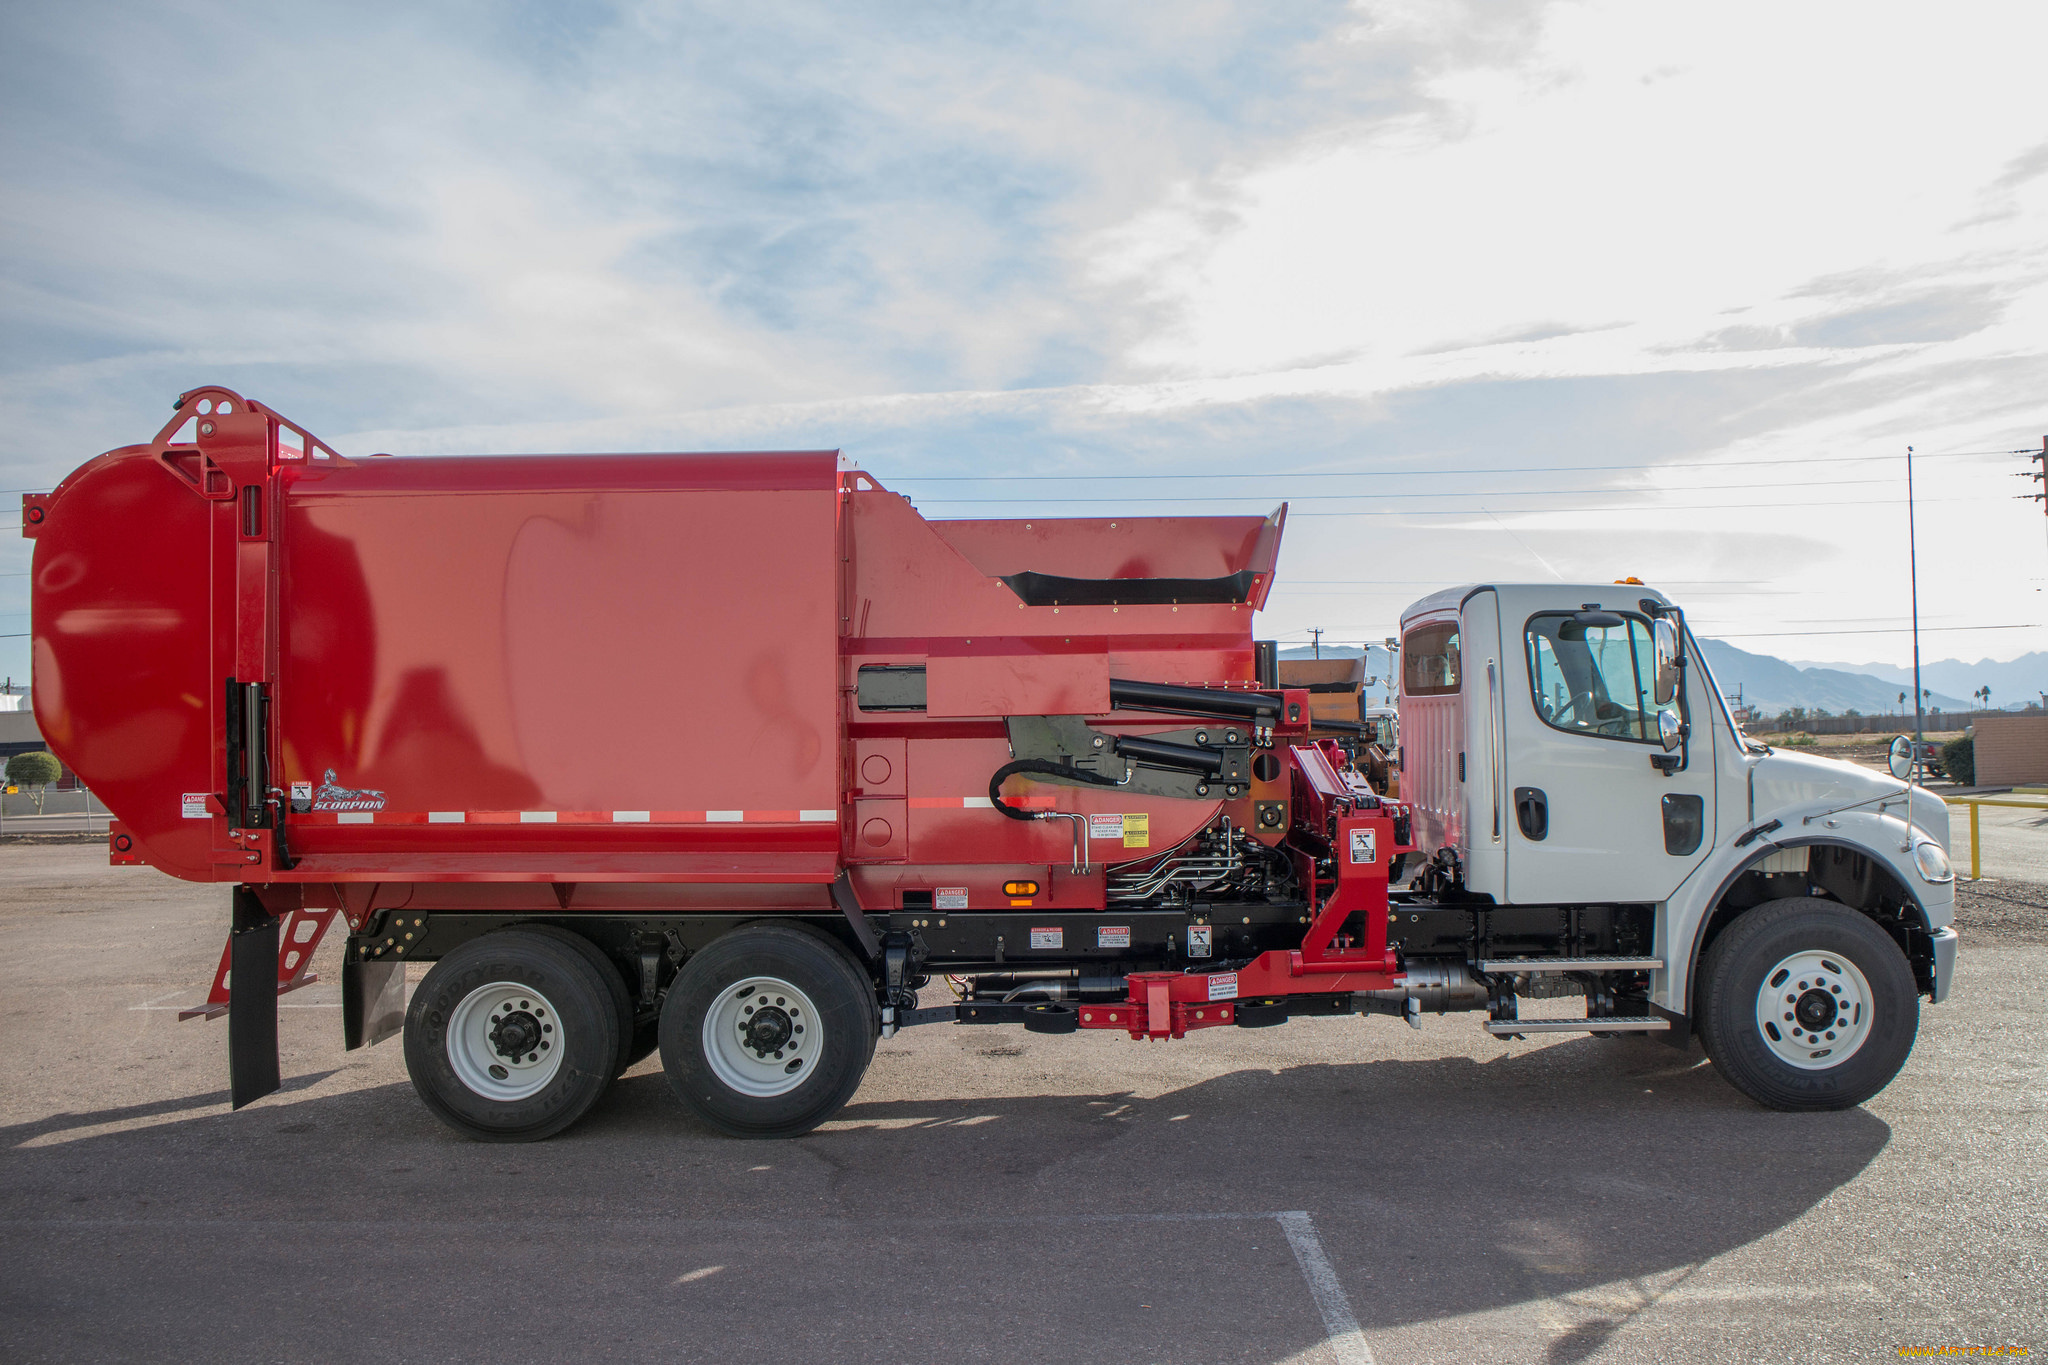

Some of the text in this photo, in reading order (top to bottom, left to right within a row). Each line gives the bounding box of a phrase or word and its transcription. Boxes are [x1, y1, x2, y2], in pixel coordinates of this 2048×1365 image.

[313, 801, 385, 810] SCORPION
[1216, 976, 1234, 984] DANGER
[427, 963, 546, 1042] GOODYEAR
